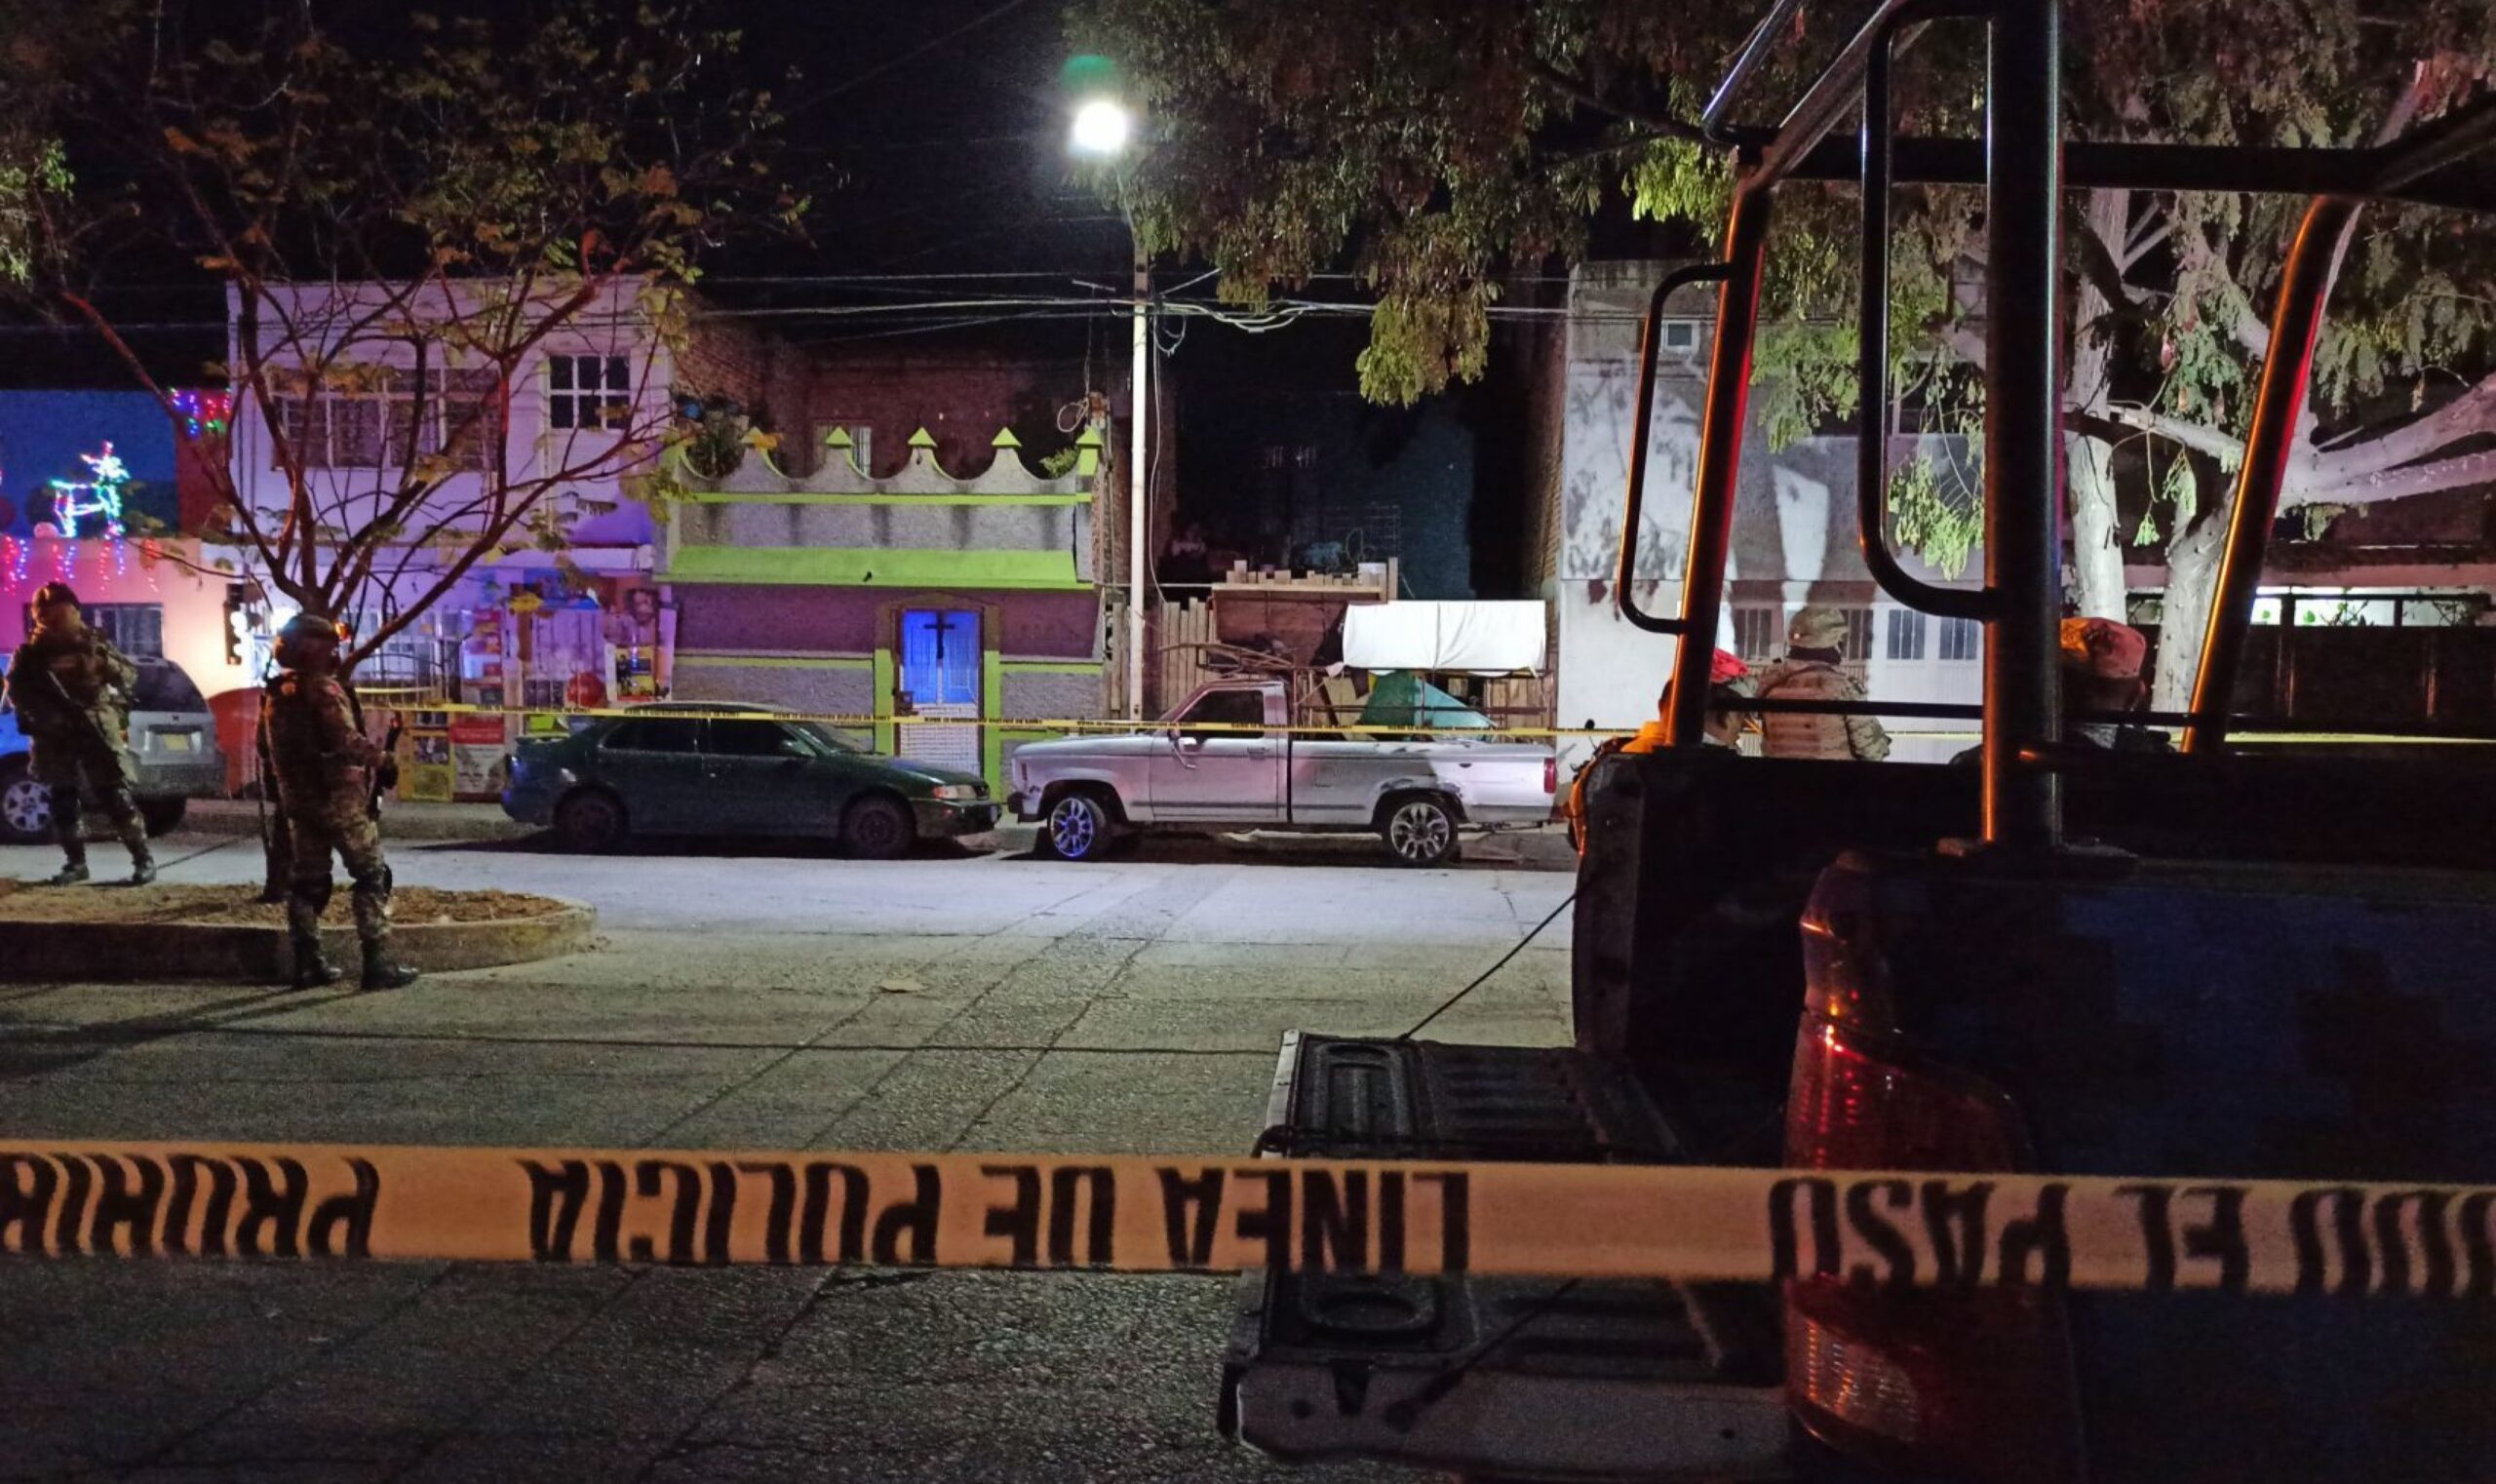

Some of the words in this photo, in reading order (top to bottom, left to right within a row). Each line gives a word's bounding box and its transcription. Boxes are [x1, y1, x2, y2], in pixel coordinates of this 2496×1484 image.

[516, 1160, 943, 1266] POLICIA
[979, 1163, 1116, 1267] DE
[1153, 1167, 1471, 1273] LINEA
[1768, 1176, 2073, 1287] PASO
[2113, 1185, 2253, 1292] EL
